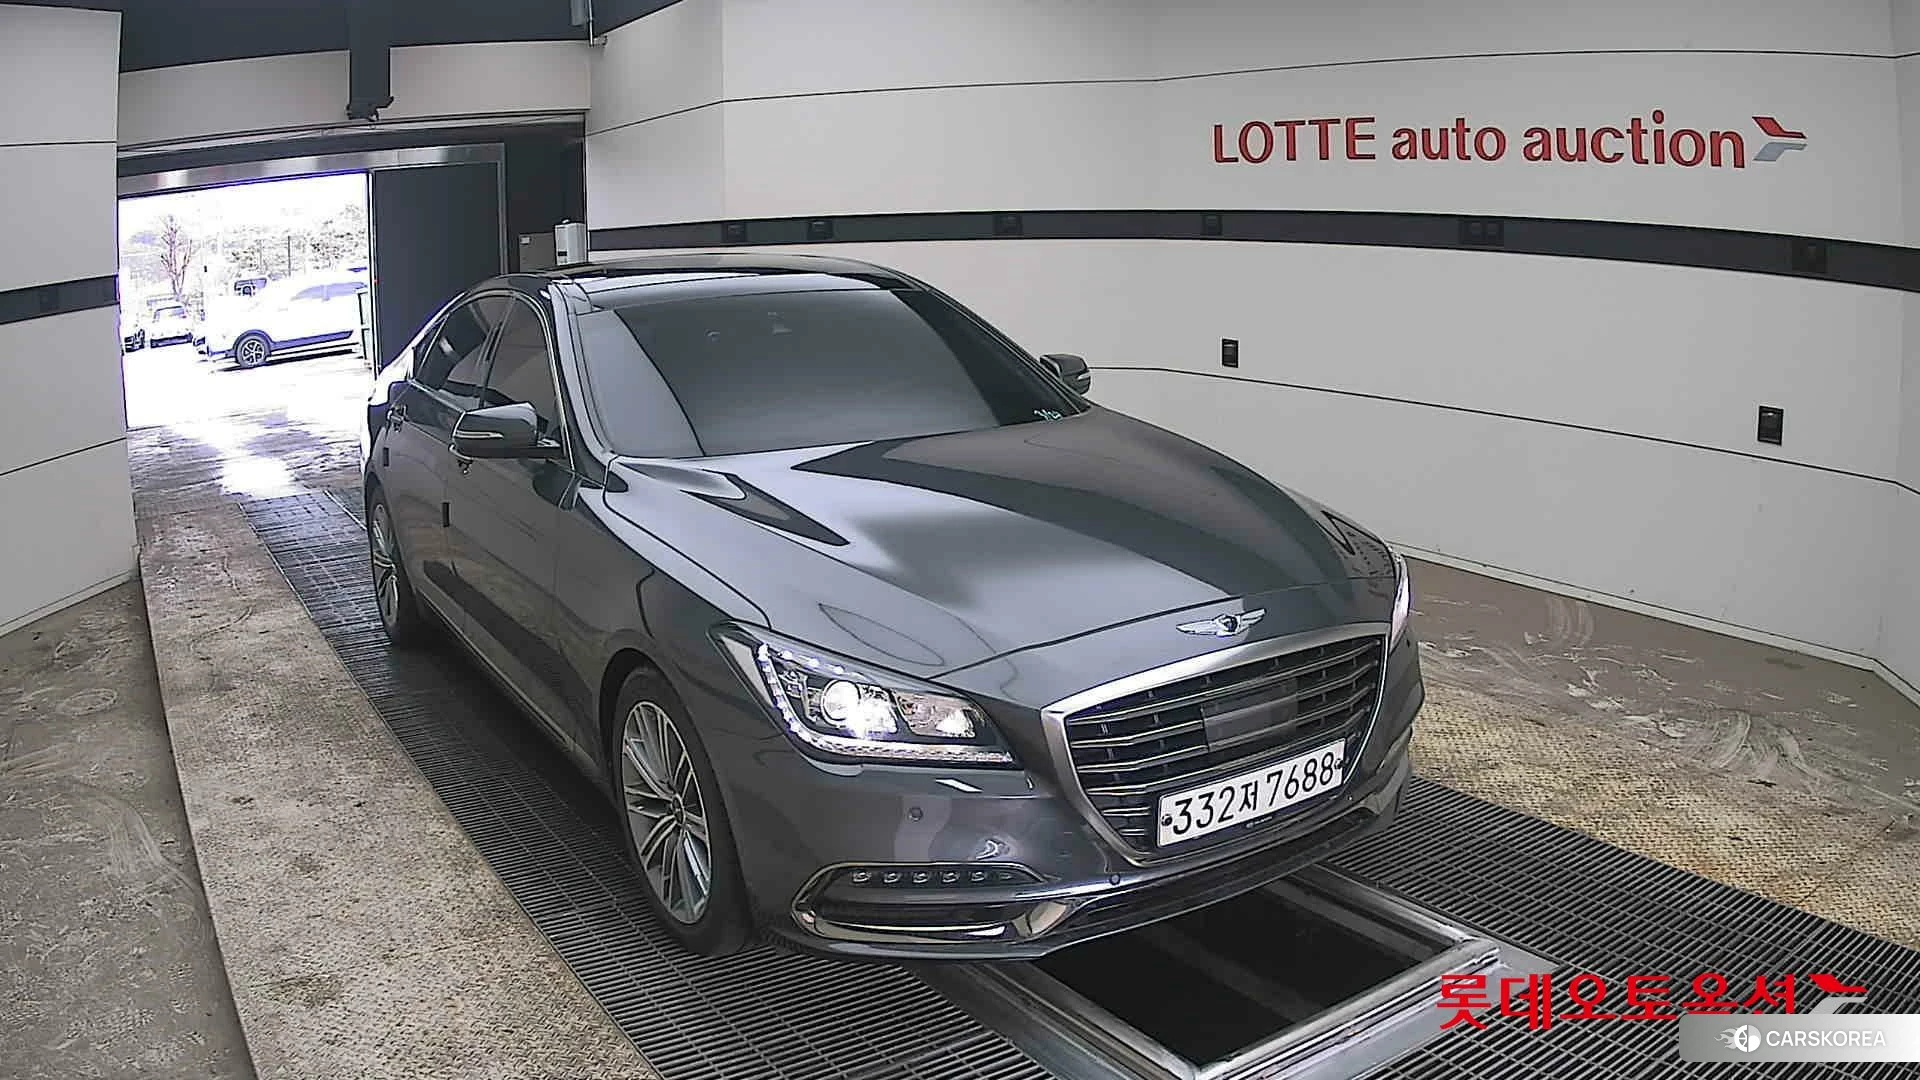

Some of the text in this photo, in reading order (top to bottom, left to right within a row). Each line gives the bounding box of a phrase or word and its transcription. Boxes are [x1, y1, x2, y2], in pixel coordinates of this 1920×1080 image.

[1213, 110, 1746, 168] LOTTE auto auction
